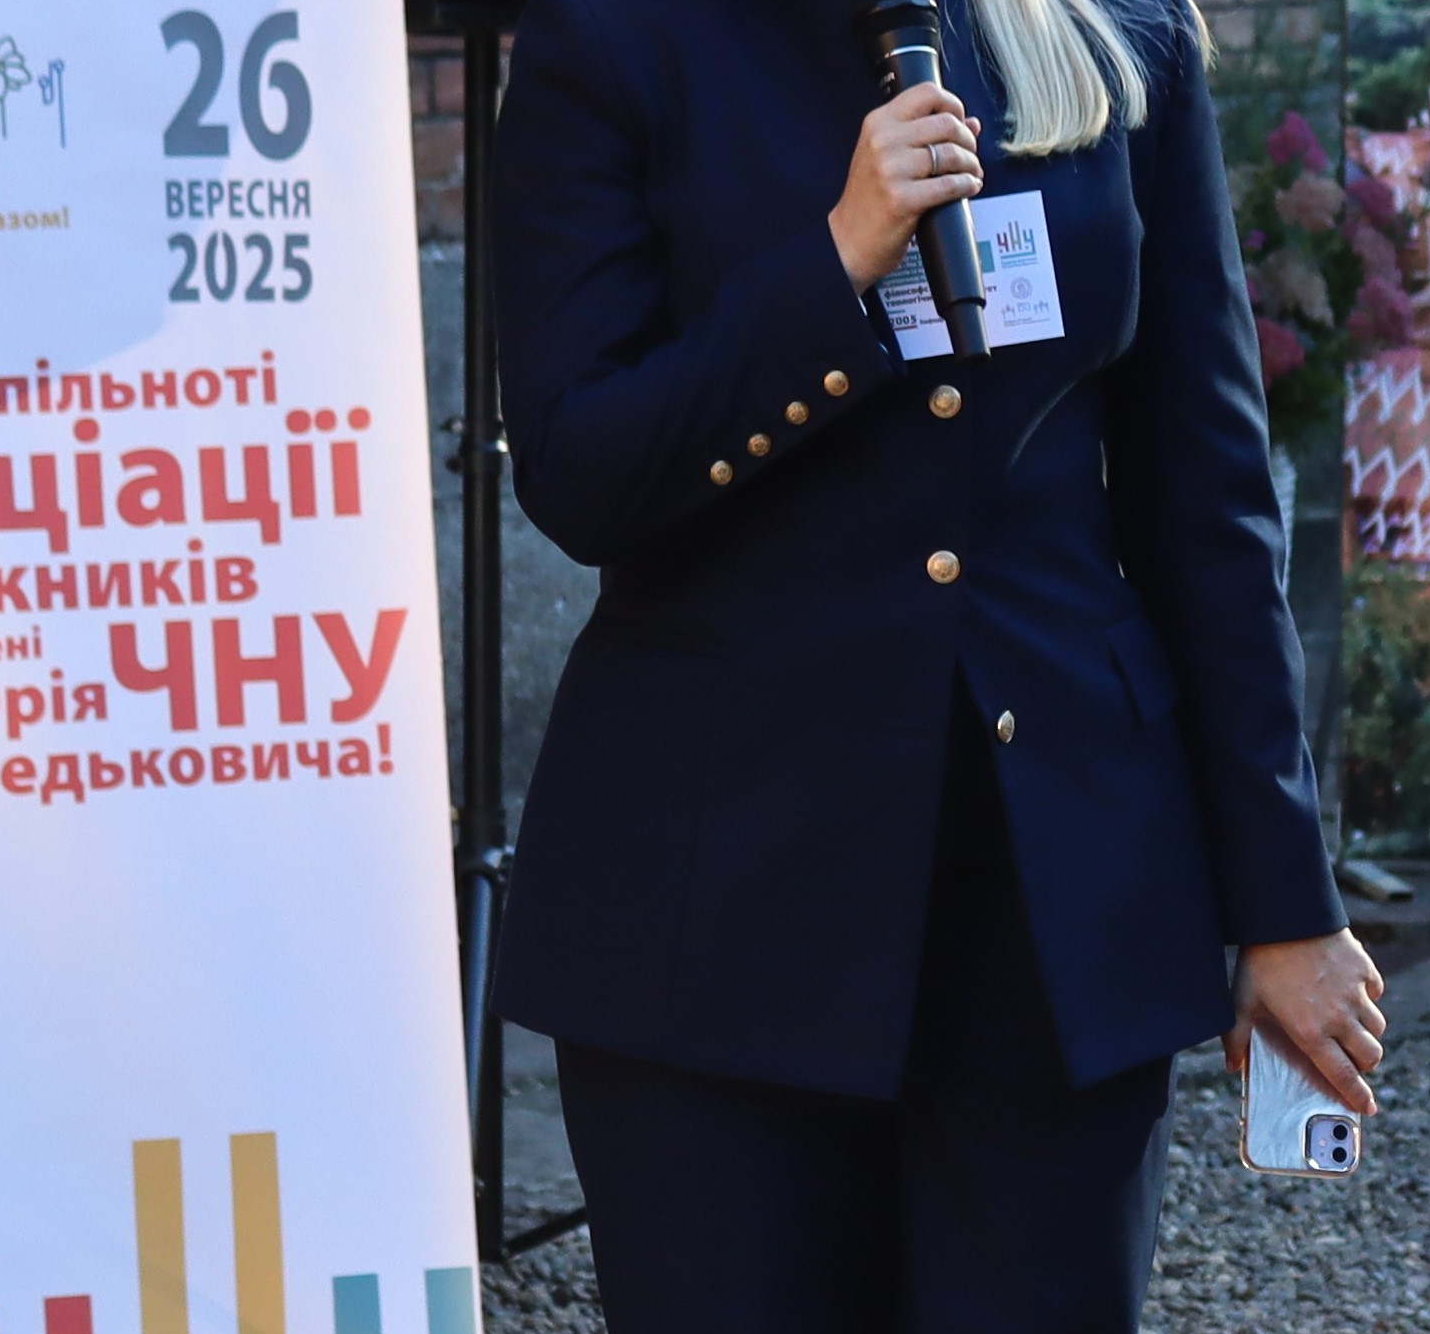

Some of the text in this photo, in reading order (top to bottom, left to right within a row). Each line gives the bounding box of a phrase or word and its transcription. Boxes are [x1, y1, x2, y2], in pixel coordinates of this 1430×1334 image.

[159, 9, 313, 161] 26
[164, 179, 311, 218] ВЕРЕСНЯ
[167, 230, 313, 303] 2025
[107, 607, 409, 732] ЧНУ
